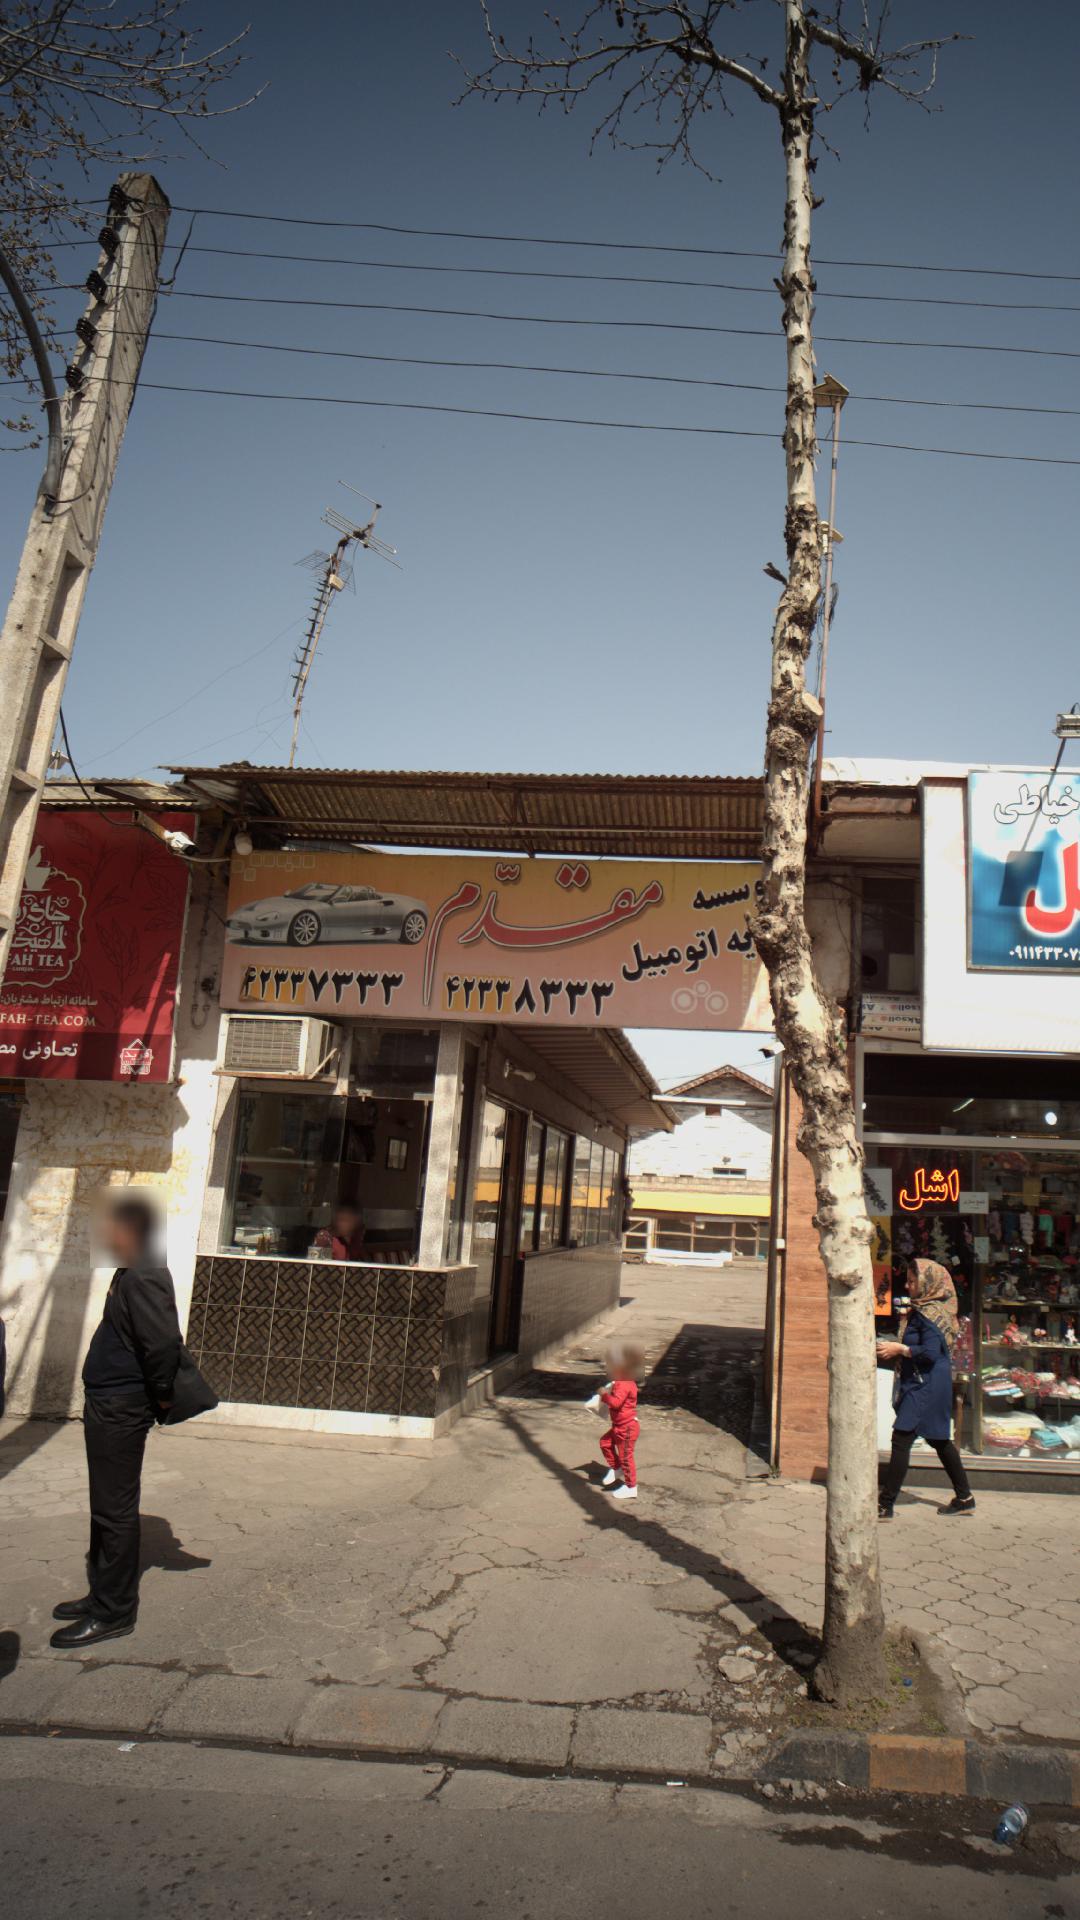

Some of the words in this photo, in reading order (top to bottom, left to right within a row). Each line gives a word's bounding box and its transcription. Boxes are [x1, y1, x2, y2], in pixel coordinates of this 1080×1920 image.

[994, 784, 1079, 824] خیاطی
[38, 954, 65, 967] TEA
[622, 928, 719, 982] اتومبیل
[1009, 945, 1080, 961] ۰۹۱۱۴۳۳۰۷
[41, 994, 68, 1008] ارتباط
[69, 995, 98, 1006] سامانه
[446, 975, 615, 1017] ۴۲۳۳۸۳۳۳
[22, 1040, 78, 1060] تعاونی
[899, 1168, 960, 1211] اشل
